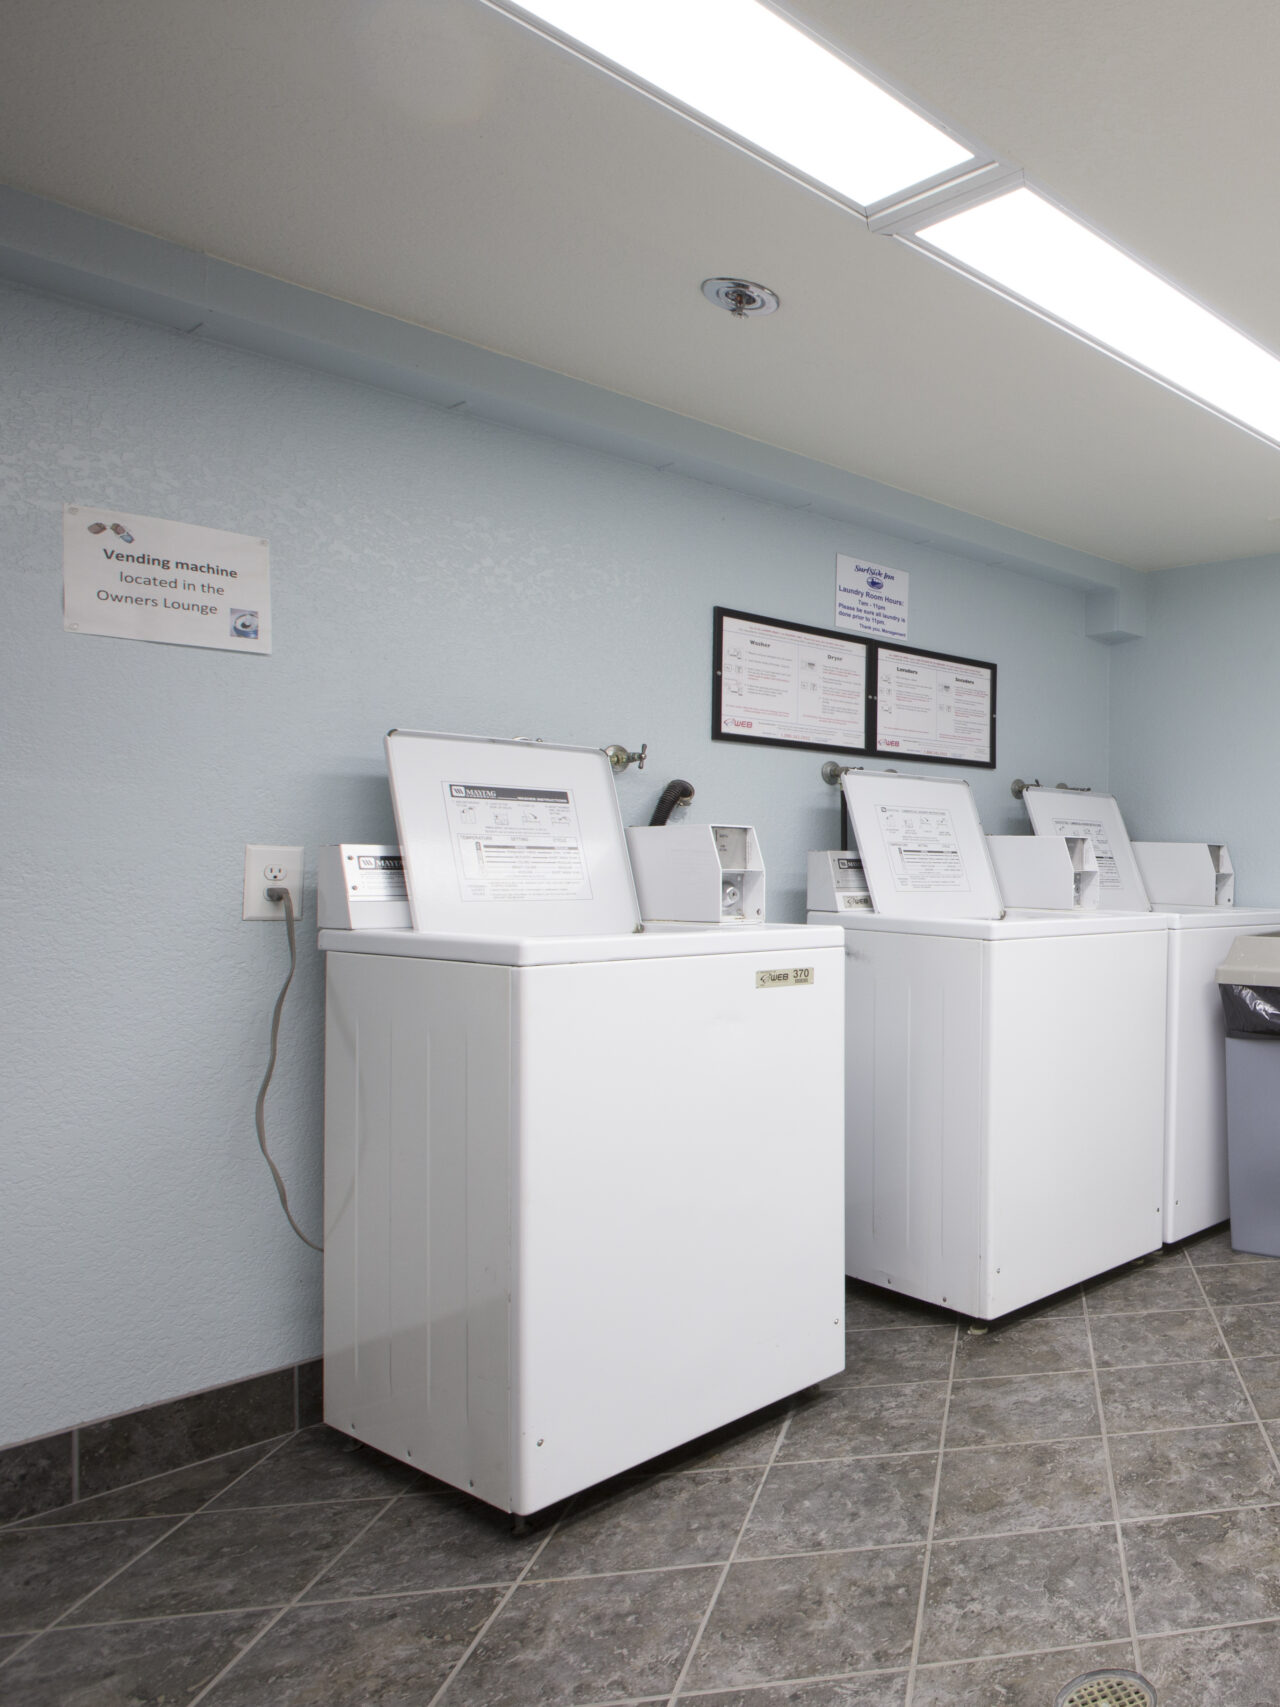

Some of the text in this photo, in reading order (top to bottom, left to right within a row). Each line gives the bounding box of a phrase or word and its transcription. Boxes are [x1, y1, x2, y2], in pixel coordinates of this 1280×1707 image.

[103, 548, 238, 578] Vending machine
[119, 571, 225, 596] located in the
[96, 590, 218, 615] Owners Lounge
[838, 585, 905, 607] Laundry Room Hours:
[838, 602, 855, 611] Please
[882, 613, 900, 622] laundry
[873, 603, 886, 611] 11pm
[734, 720, 752, 728] WEB
[885, 739, 900, 747] WEB
[465, 788, 497, 797] MAYTAG
[770, 968, 810, 981] WEB 370
